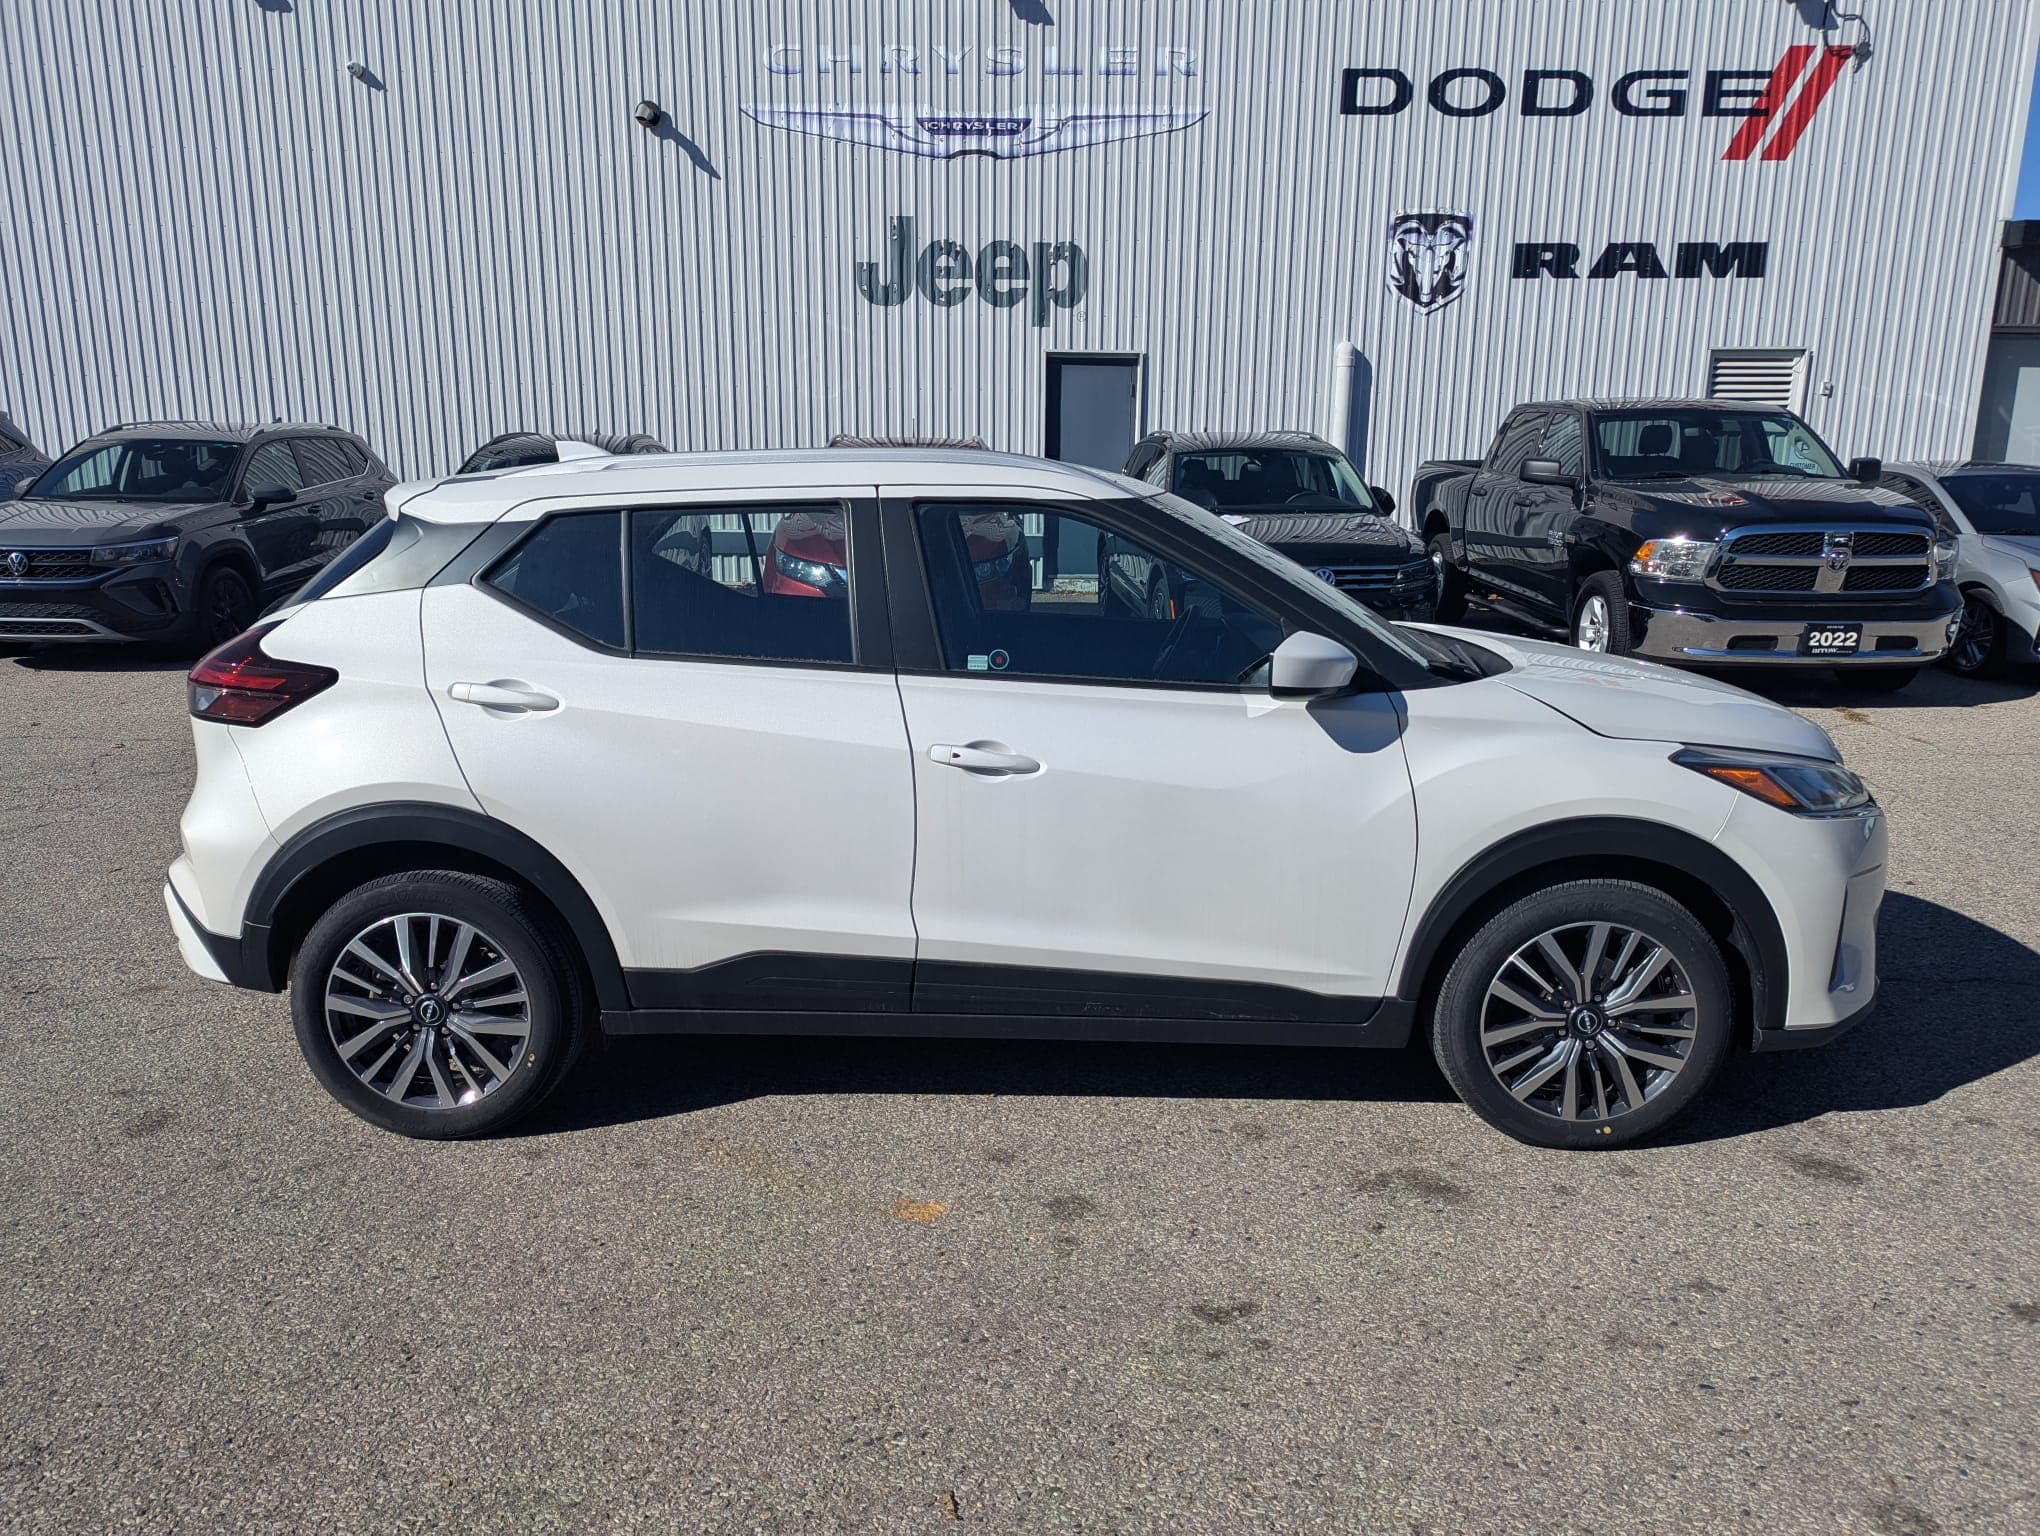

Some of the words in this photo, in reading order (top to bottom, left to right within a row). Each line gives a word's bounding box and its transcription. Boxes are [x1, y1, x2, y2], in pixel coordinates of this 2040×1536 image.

[763, 44, 1199, 76] CHRYSLER
[1340, 67, 1769, 117] DODGE
[928, 121, 1018, 131] CHRYSLER
[857, 215, 1087, 327] Jeep
[1512, 241, 1768, 279] RAM
[1809, 631, 1858, 647] 2022
